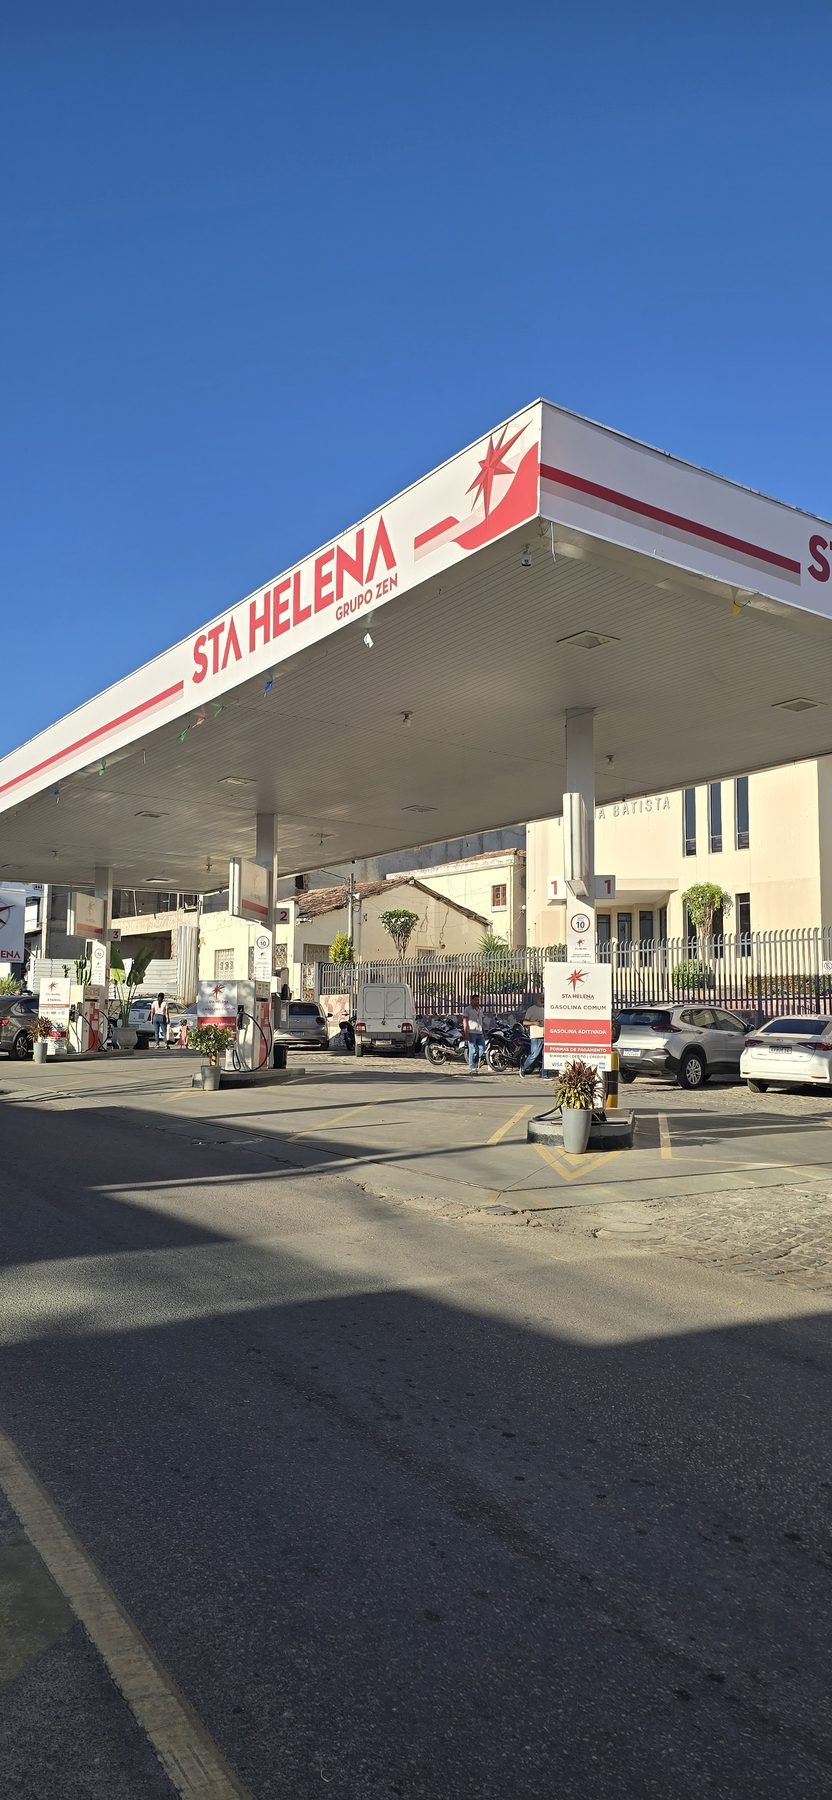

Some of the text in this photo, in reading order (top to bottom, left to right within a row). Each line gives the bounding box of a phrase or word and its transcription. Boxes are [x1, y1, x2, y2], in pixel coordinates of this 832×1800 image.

[808, 535, 832, 583] S
[192, 515, 397, 684] STA HELENA
[335, 573, 398, 621] GRUPO ZEN
[613, 796, 671, 817] BATISTA
[551, 880, 557, 895] 1
[604, 879, 611, 894] 1
[279, 910, 288, 922] 2
[576, 921, 585, 929] 10
[113, 931, 119, 940] 3
